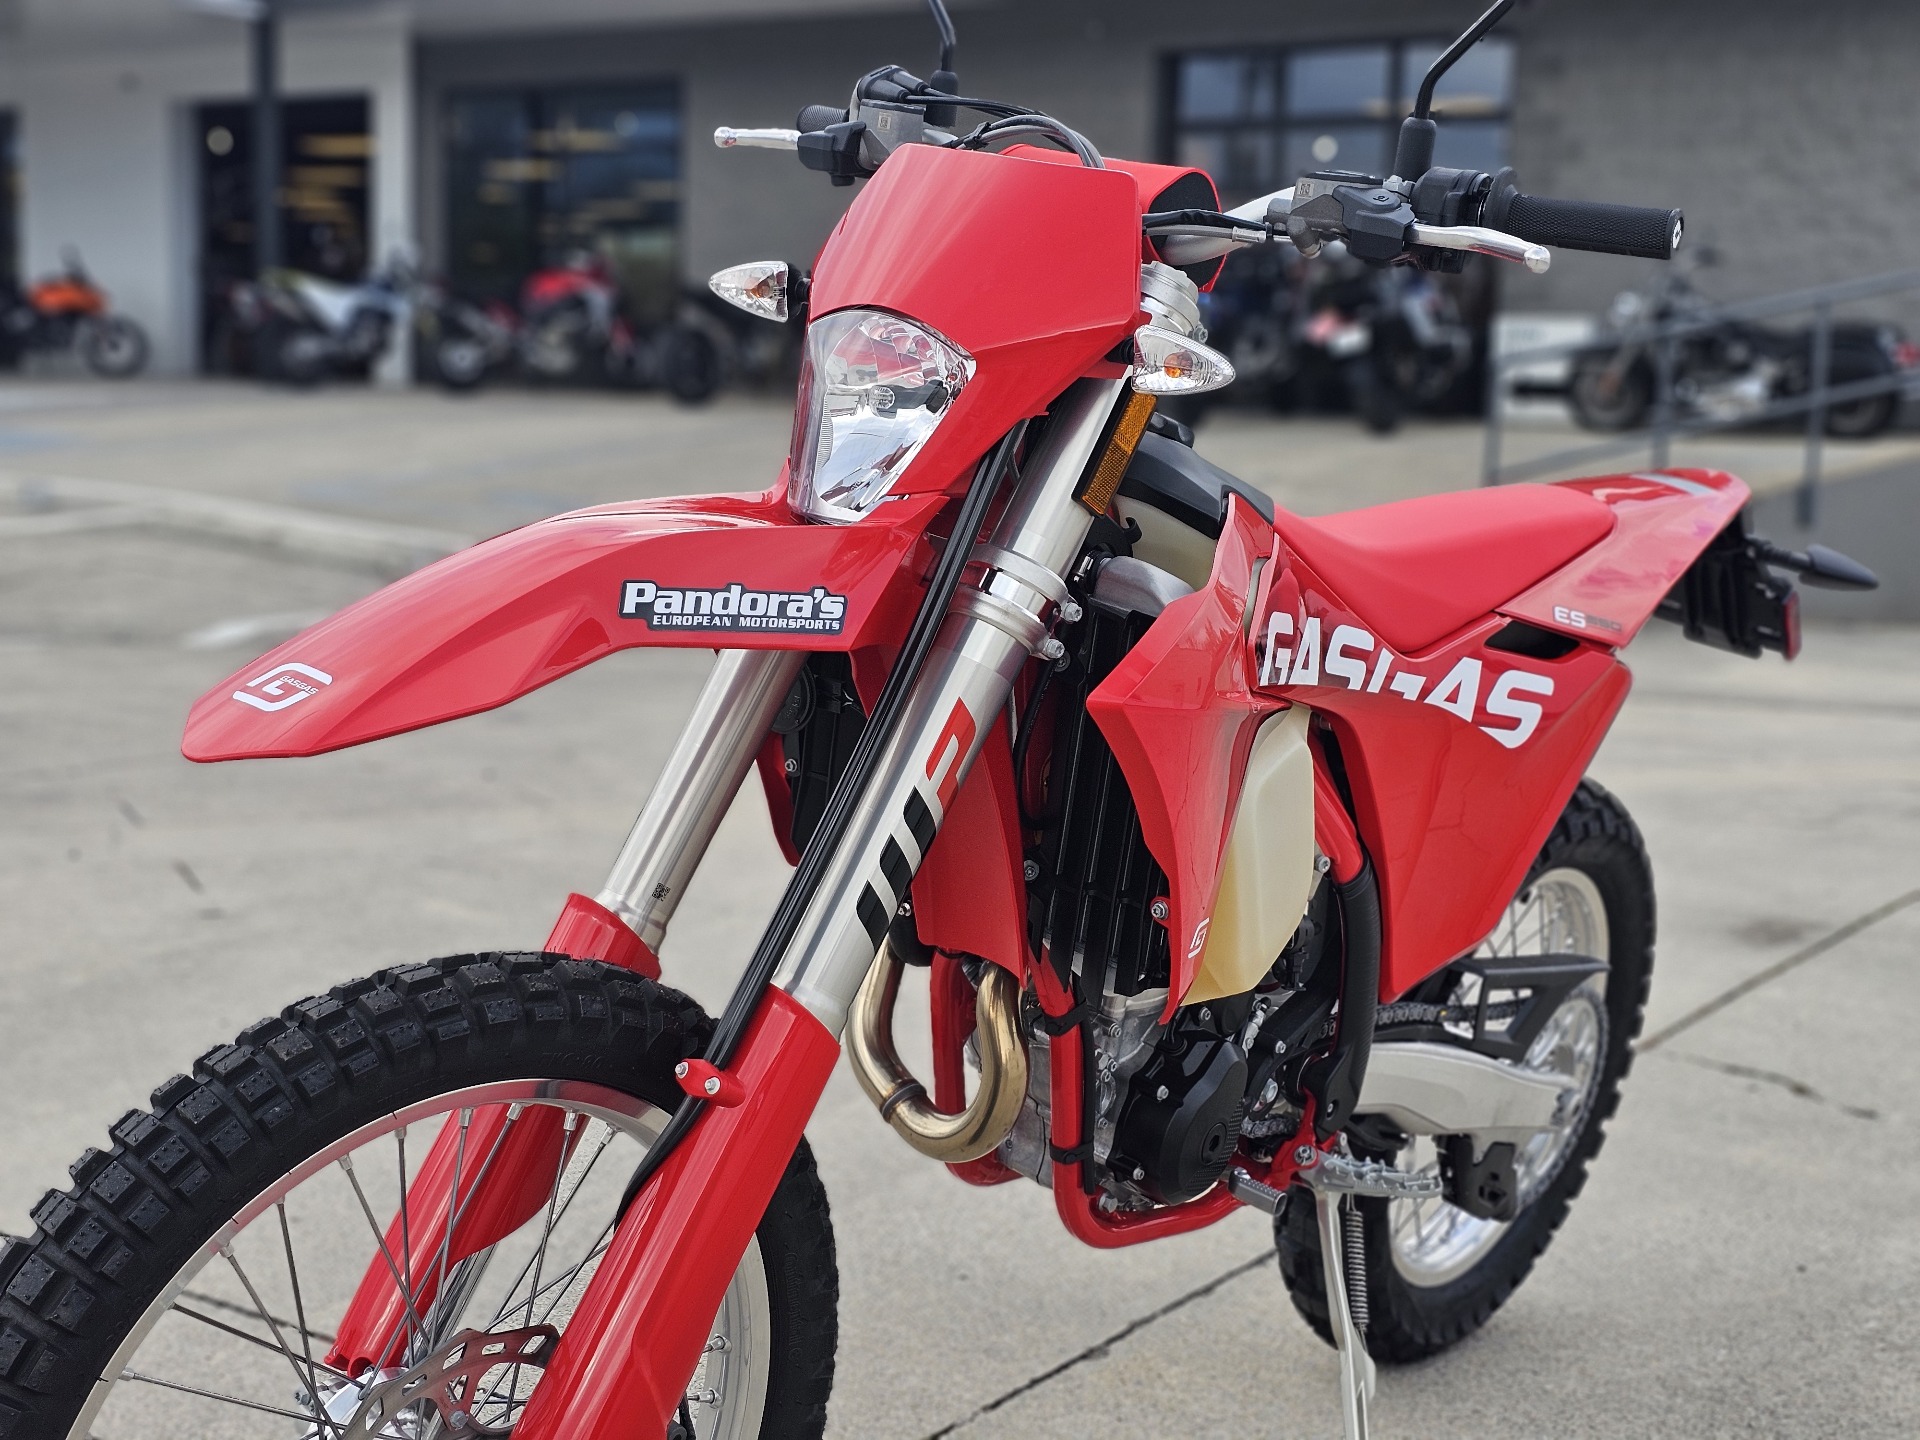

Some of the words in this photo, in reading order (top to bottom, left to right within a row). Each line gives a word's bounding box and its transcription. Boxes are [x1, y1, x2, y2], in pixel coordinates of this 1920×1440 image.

[622, 582, 845, 619] Pandora's
[653, 615, 732, 627] EUROPEAN
[739, 616, 840, 630] MOTORSPORTS
